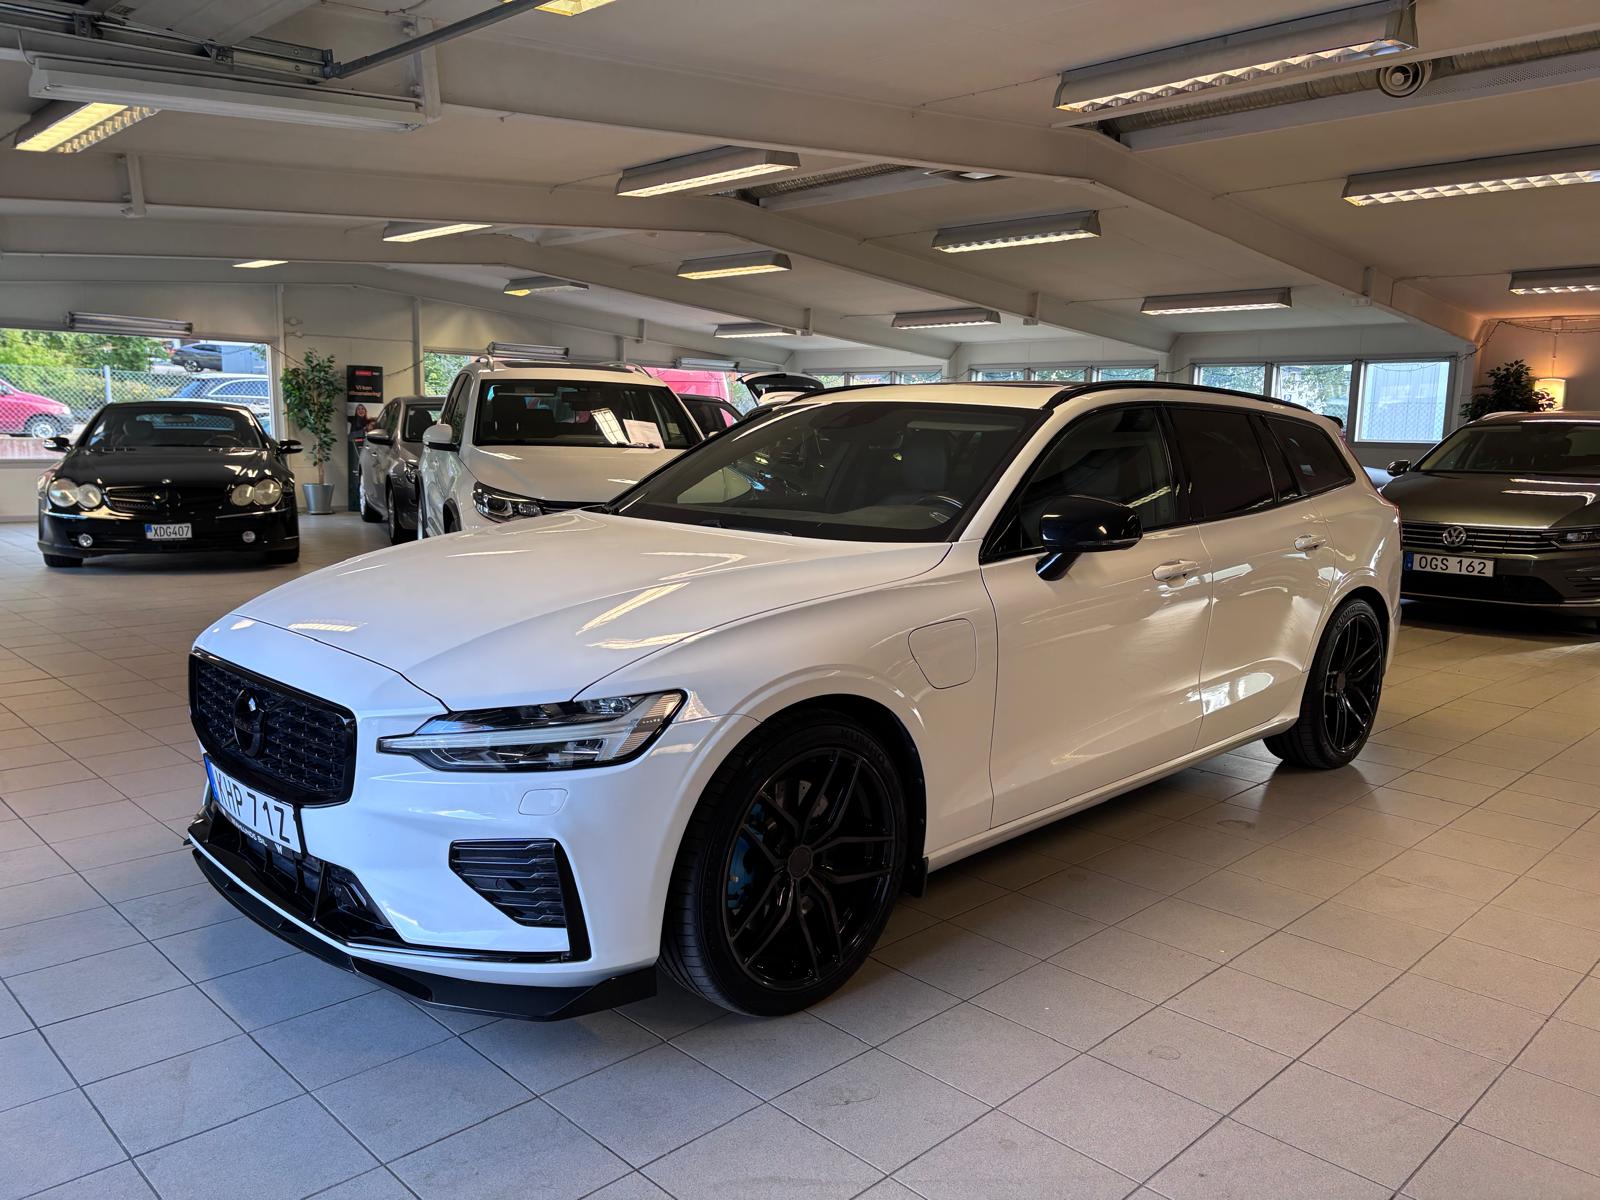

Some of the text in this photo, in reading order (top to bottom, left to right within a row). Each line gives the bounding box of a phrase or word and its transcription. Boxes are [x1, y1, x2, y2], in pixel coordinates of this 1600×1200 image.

[153, 525, 190, 537] XDG407
[1419, 556, 1487, 575] OGS 162
[247, 791, 291, 844] 71Z
